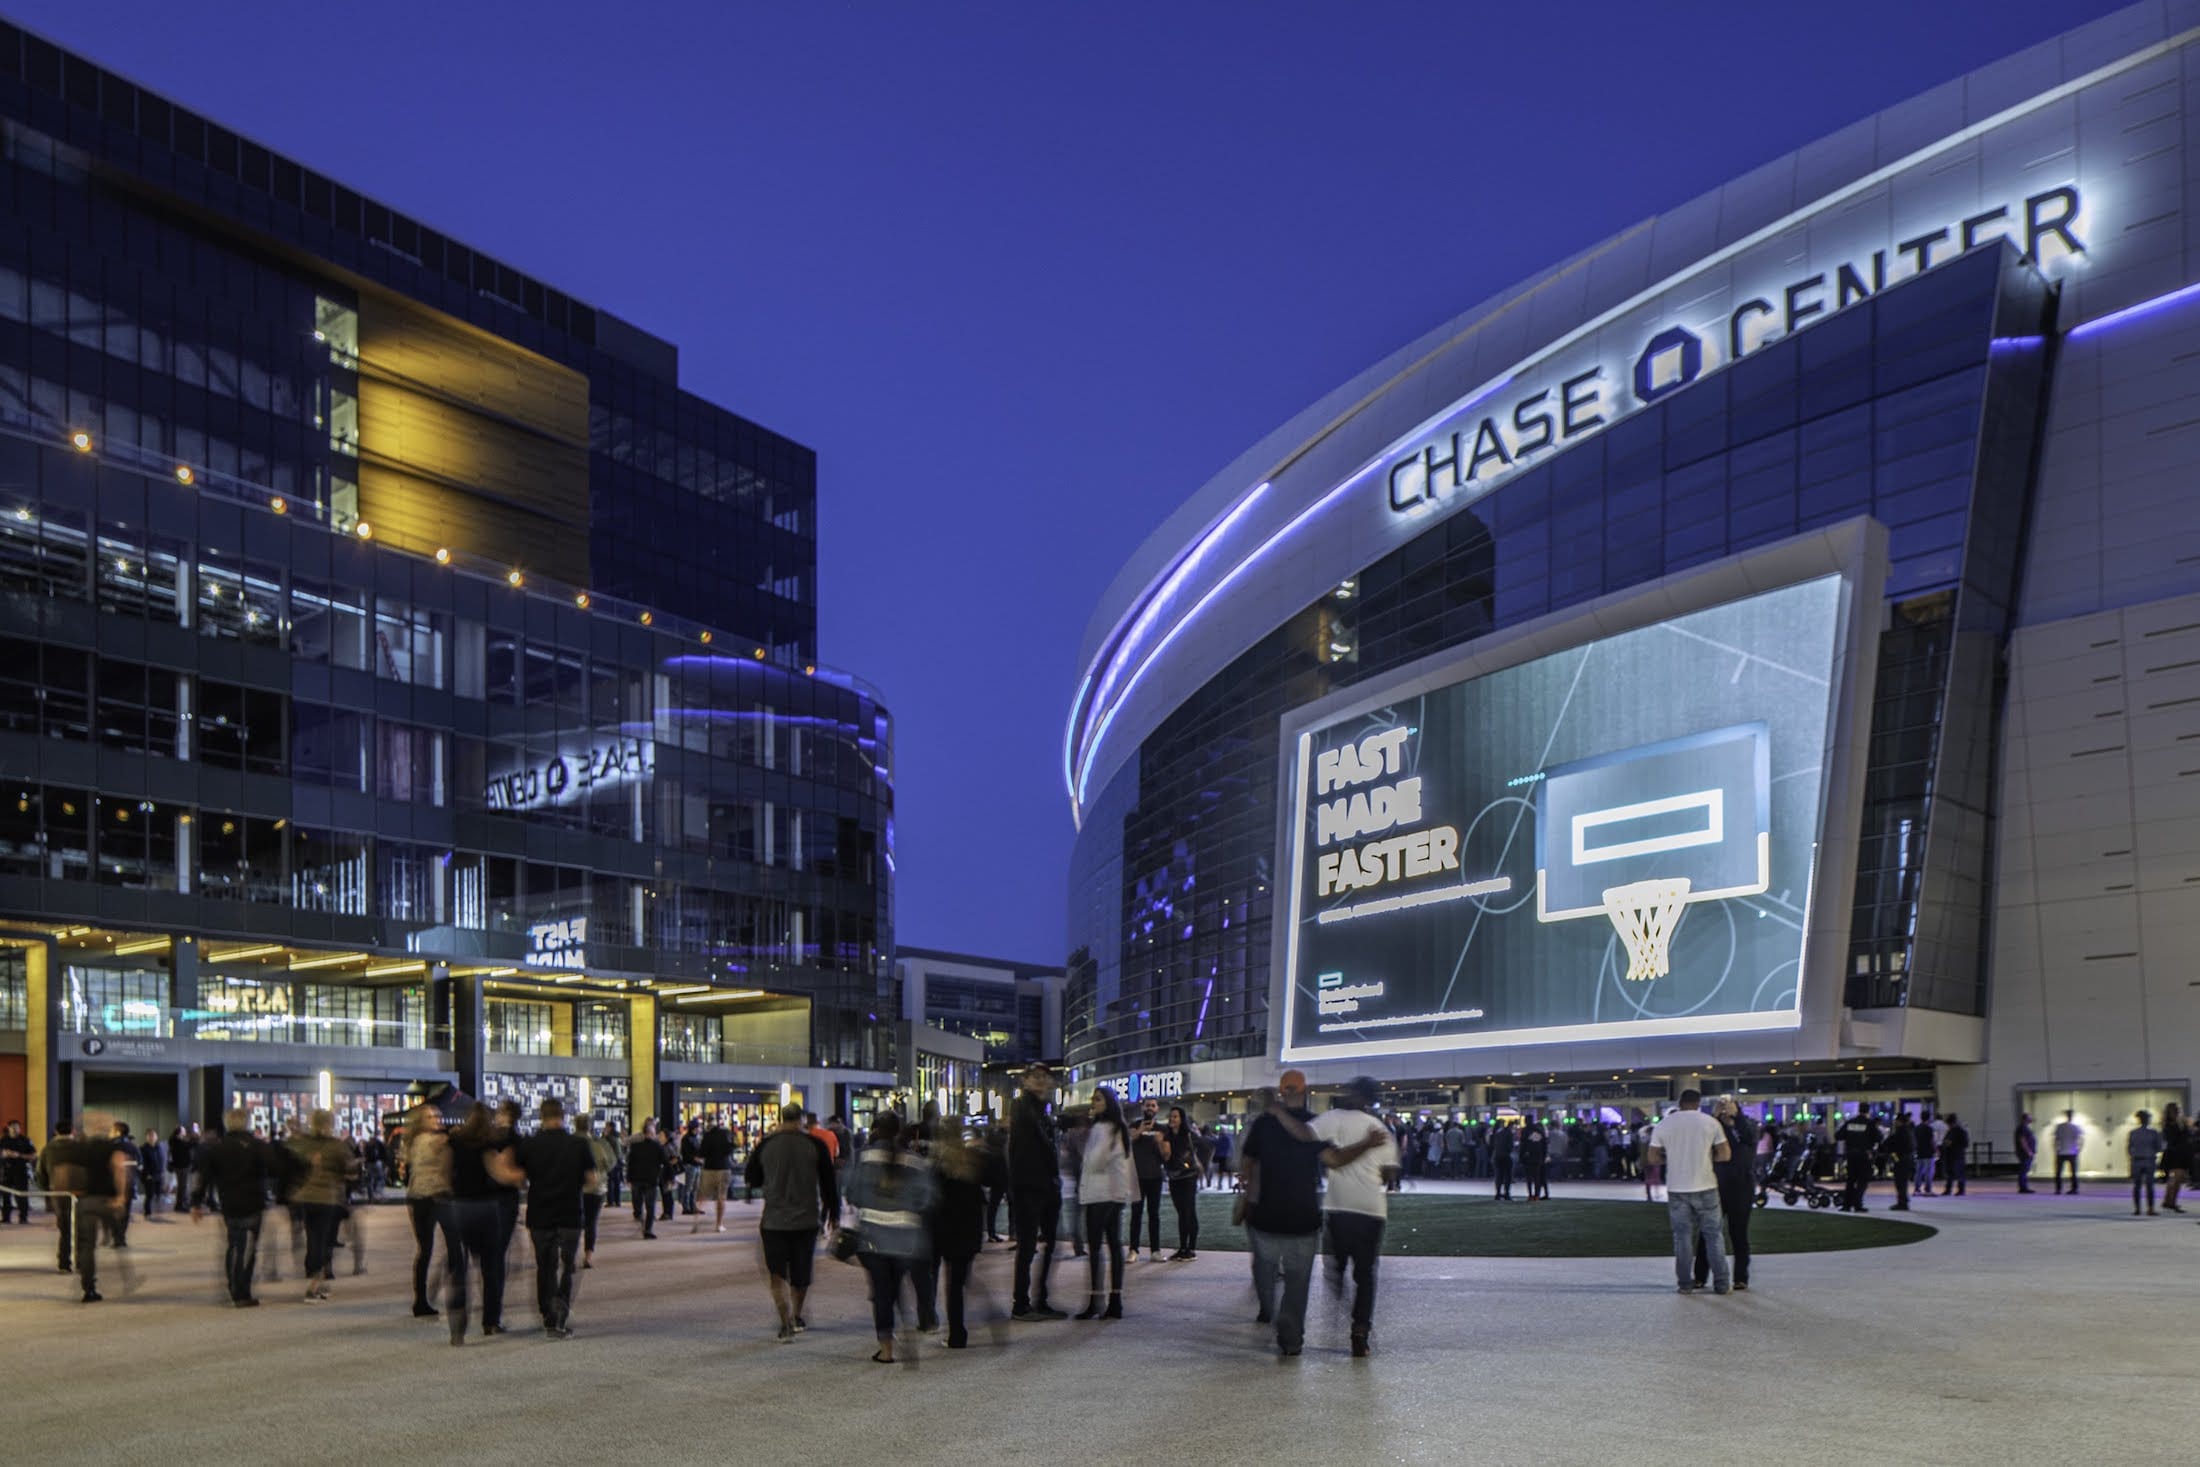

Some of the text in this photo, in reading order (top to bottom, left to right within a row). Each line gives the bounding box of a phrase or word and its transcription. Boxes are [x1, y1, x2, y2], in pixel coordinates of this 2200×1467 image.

[1388, 365, 1606, 512] CHASE
[1317, 726, 1408, 796] FAST
[1318, 776, 1423, 846] MADE
[1318, 825, 1460, 897] FASTER
[1141, 1071, 1183, 1098] CENTER
